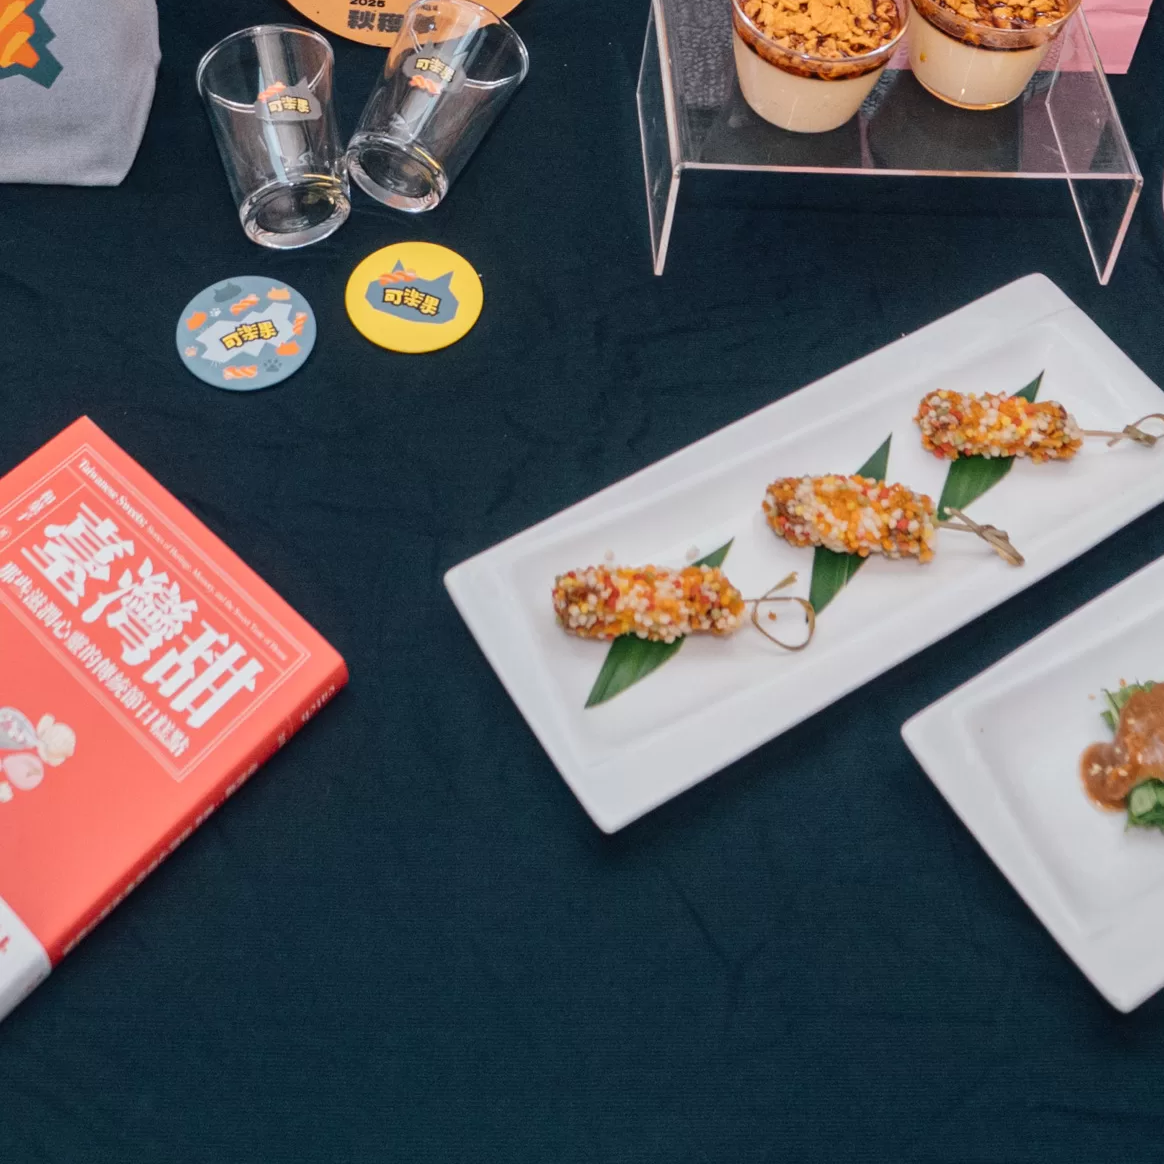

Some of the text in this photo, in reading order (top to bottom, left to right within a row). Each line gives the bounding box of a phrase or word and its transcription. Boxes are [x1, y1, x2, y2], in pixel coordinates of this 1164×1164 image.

[77, 459, 120, 500] Taiwanese
[116, 496, 149, 527] Sweets:
[21, 500, 264, 729] 臺灣甜
